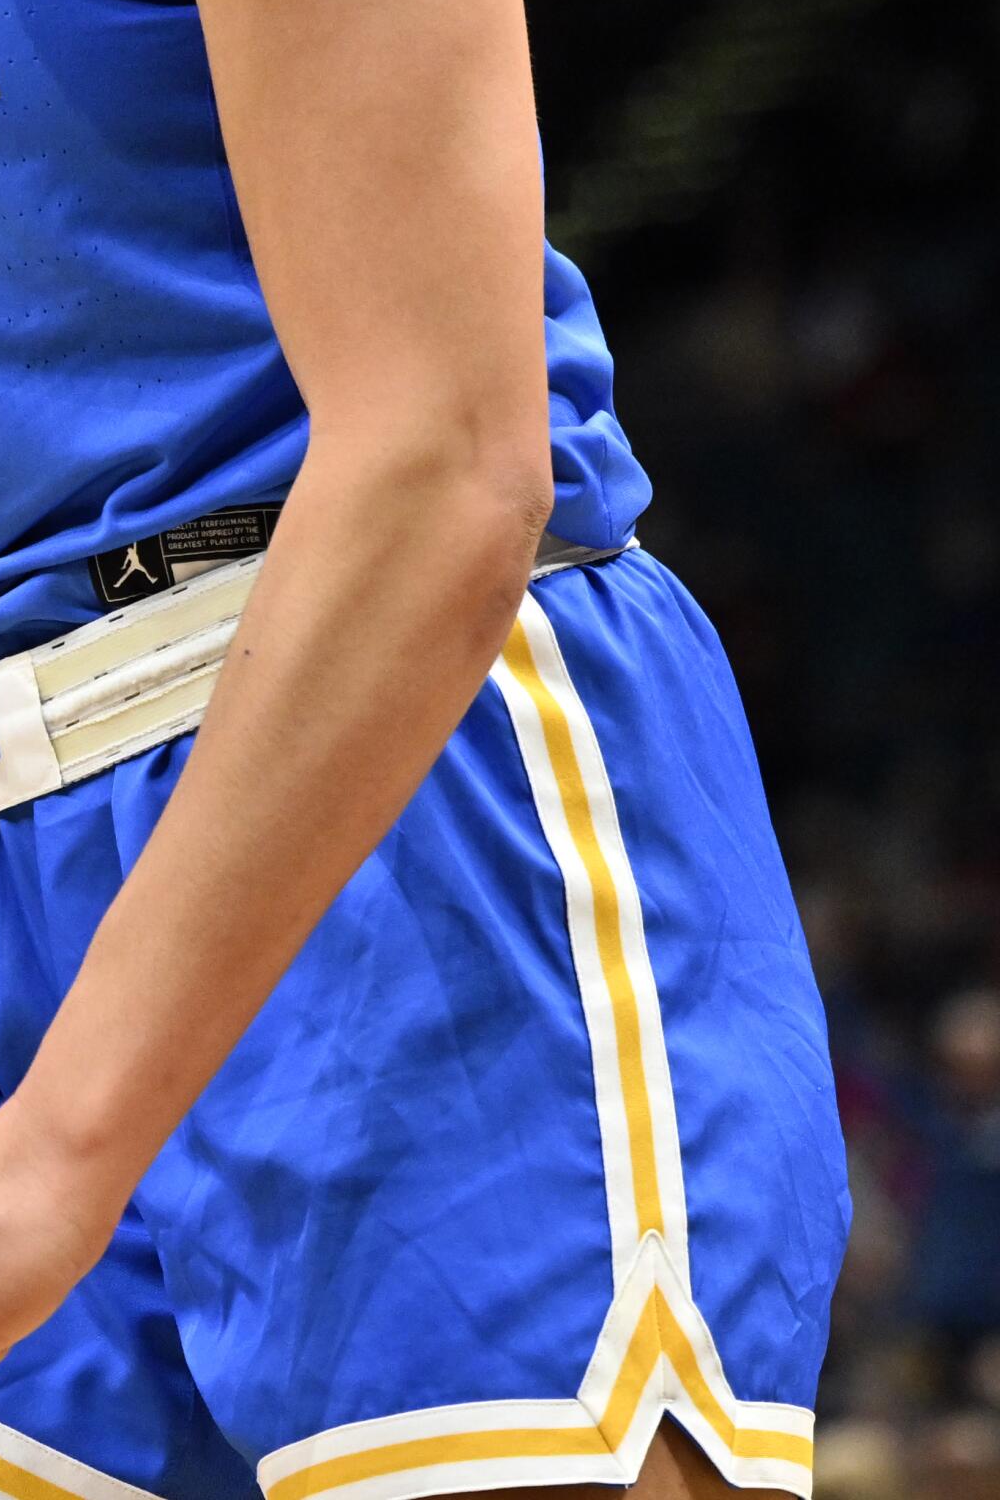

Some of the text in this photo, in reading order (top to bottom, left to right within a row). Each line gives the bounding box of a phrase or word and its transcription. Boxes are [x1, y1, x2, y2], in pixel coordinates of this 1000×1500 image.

[200, 517, 257, 528] PERFORMANCE
[167, 531, 199, 540] PRODUCT
[201, 528, 233, 537] INSPIRED
[246, 526, 259, 534] THE
[168, 536, 260, 550] GREATEST PLAYER EVER
